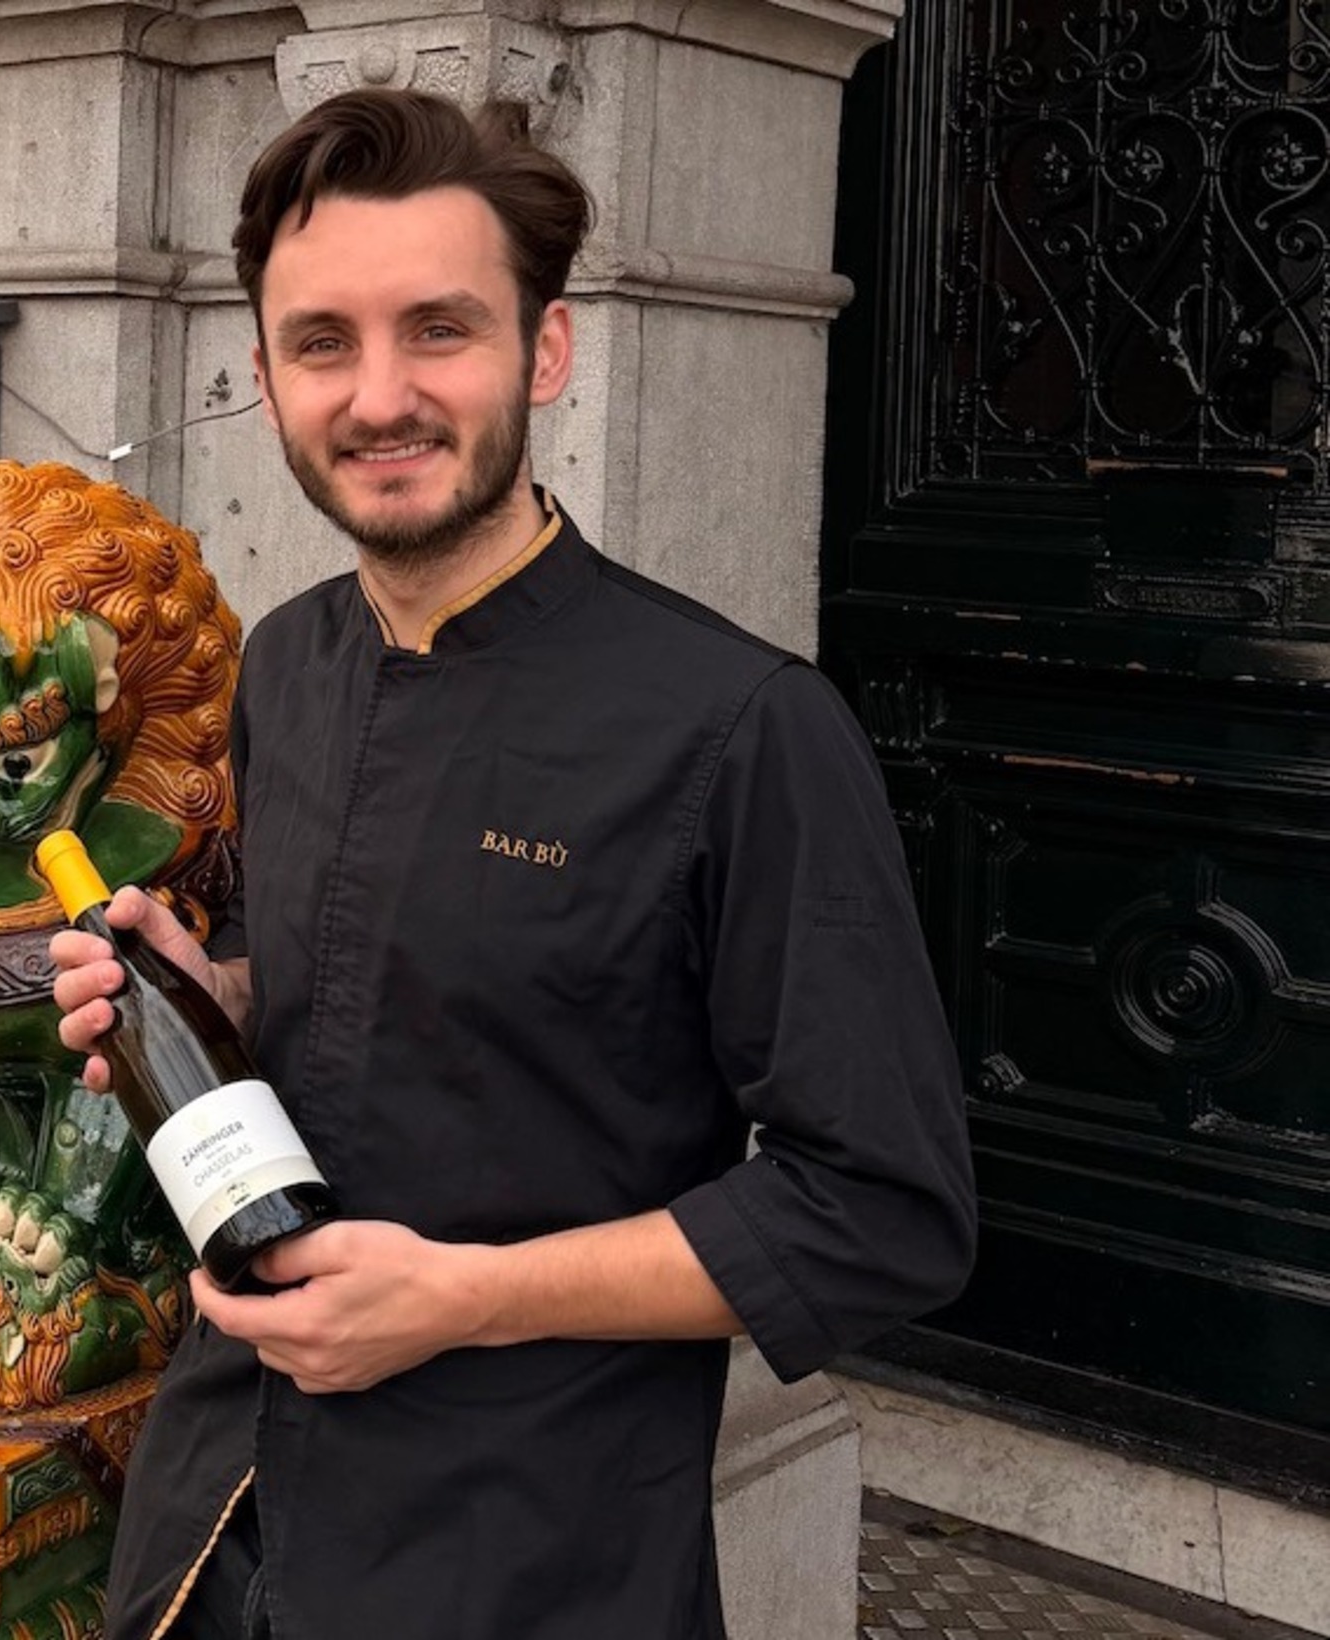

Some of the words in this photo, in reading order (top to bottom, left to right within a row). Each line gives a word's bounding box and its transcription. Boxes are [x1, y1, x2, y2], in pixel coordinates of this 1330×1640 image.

[479, 828, 530, 861] BAR
[533, 839, 569, 869] BÙ
[181, 1120, 245, 1167] ZÄHRINGER
[193, 1142, 254, 1188] CHASSELAS
